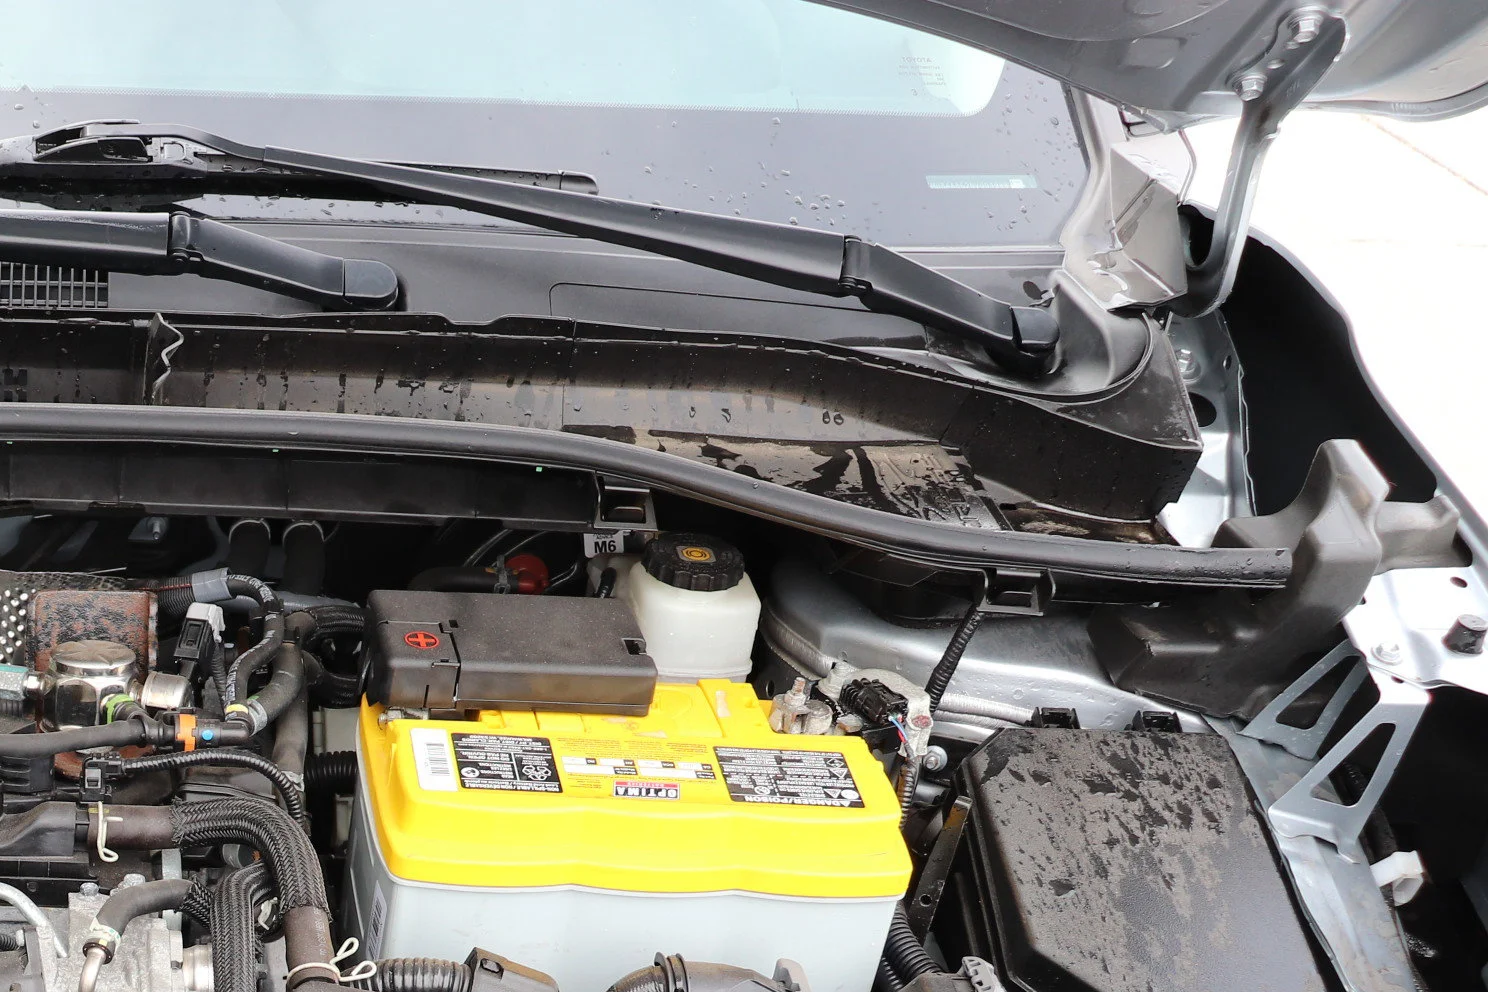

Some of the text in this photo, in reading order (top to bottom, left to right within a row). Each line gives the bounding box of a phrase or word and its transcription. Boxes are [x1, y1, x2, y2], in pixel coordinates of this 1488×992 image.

[594, 540, 616, 553] M6
[616, 786, 677, 798] OPTIMA
[744, 795, 840, 806] DANGER/POISON
